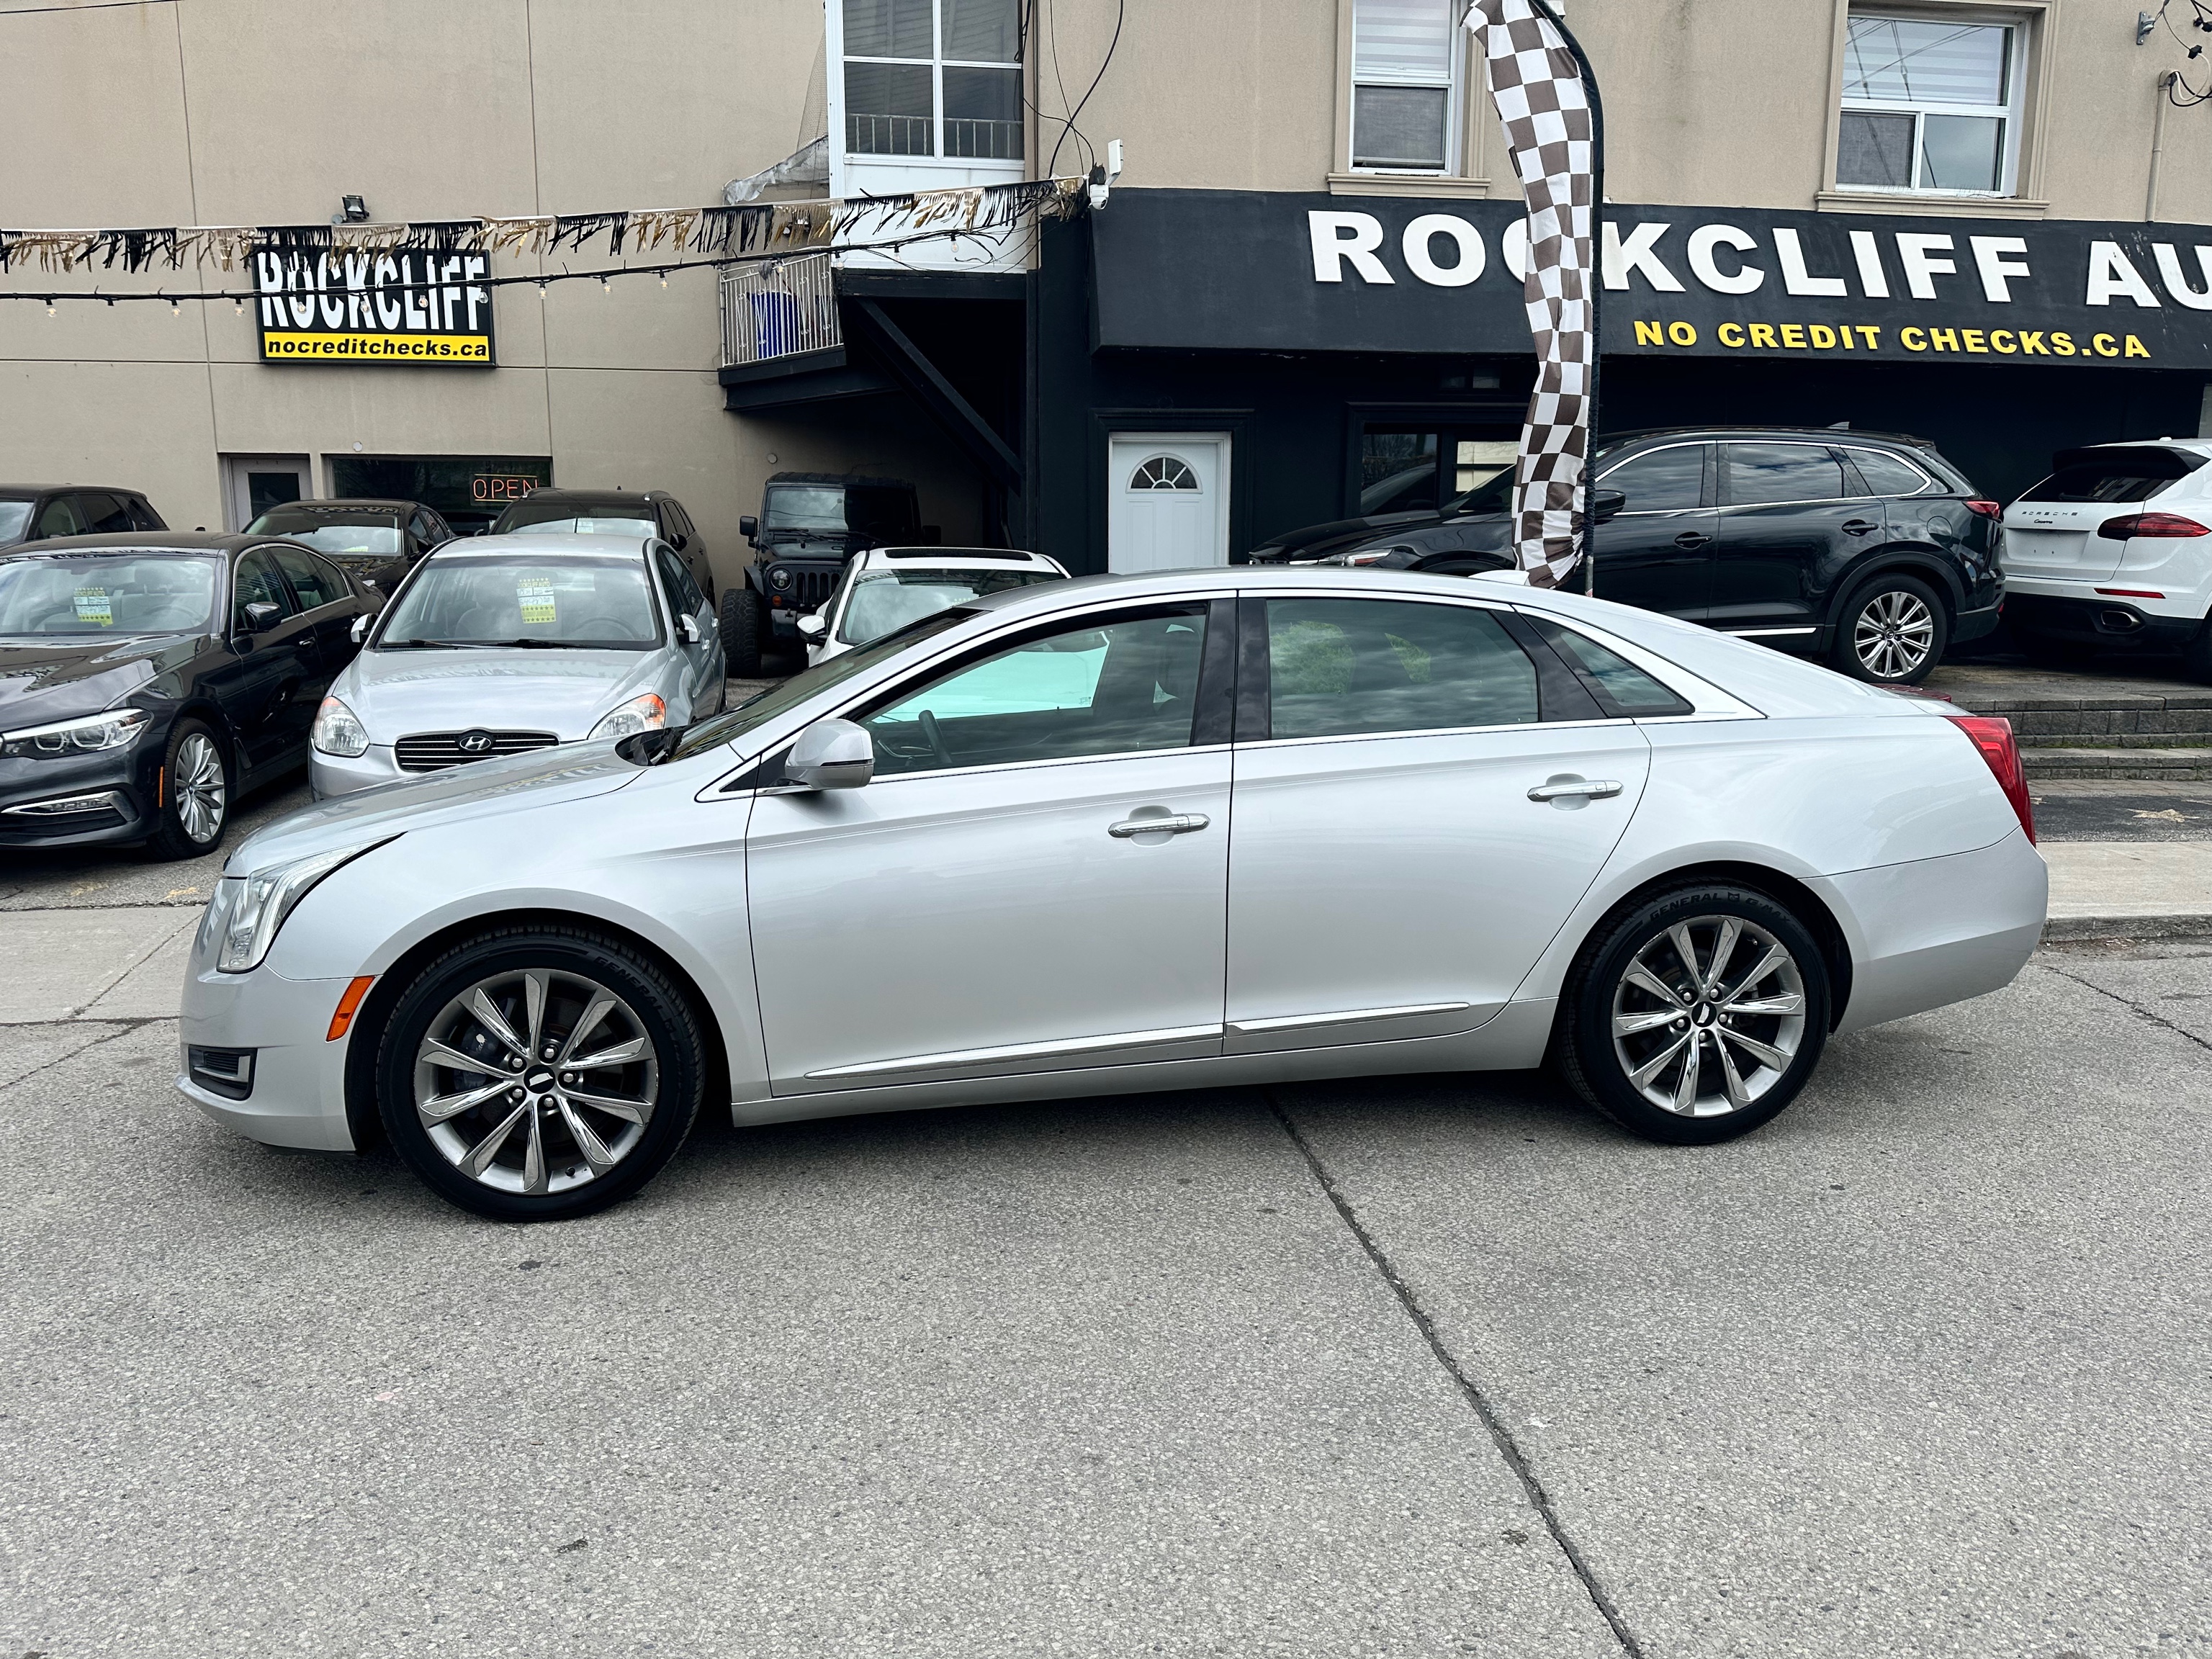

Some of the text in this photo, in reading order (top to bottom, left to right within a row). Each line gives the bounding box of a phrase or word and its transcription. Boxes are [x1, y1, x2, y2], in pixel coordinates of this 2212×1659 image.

[257, 250, 485, 331] ROCKCLIFF
[2086, 240, 2212, 311] AU
[267, 337, 487, 357] nocreditchecks.ca
[1634, 320, 2152, 359] NO CREDIT CHECKS.CA
[473, 479, 539, 499] OPEN
[1650, 892, 1722, 922] GENERAL
[593, 956, 664, 1013] GENERAL
